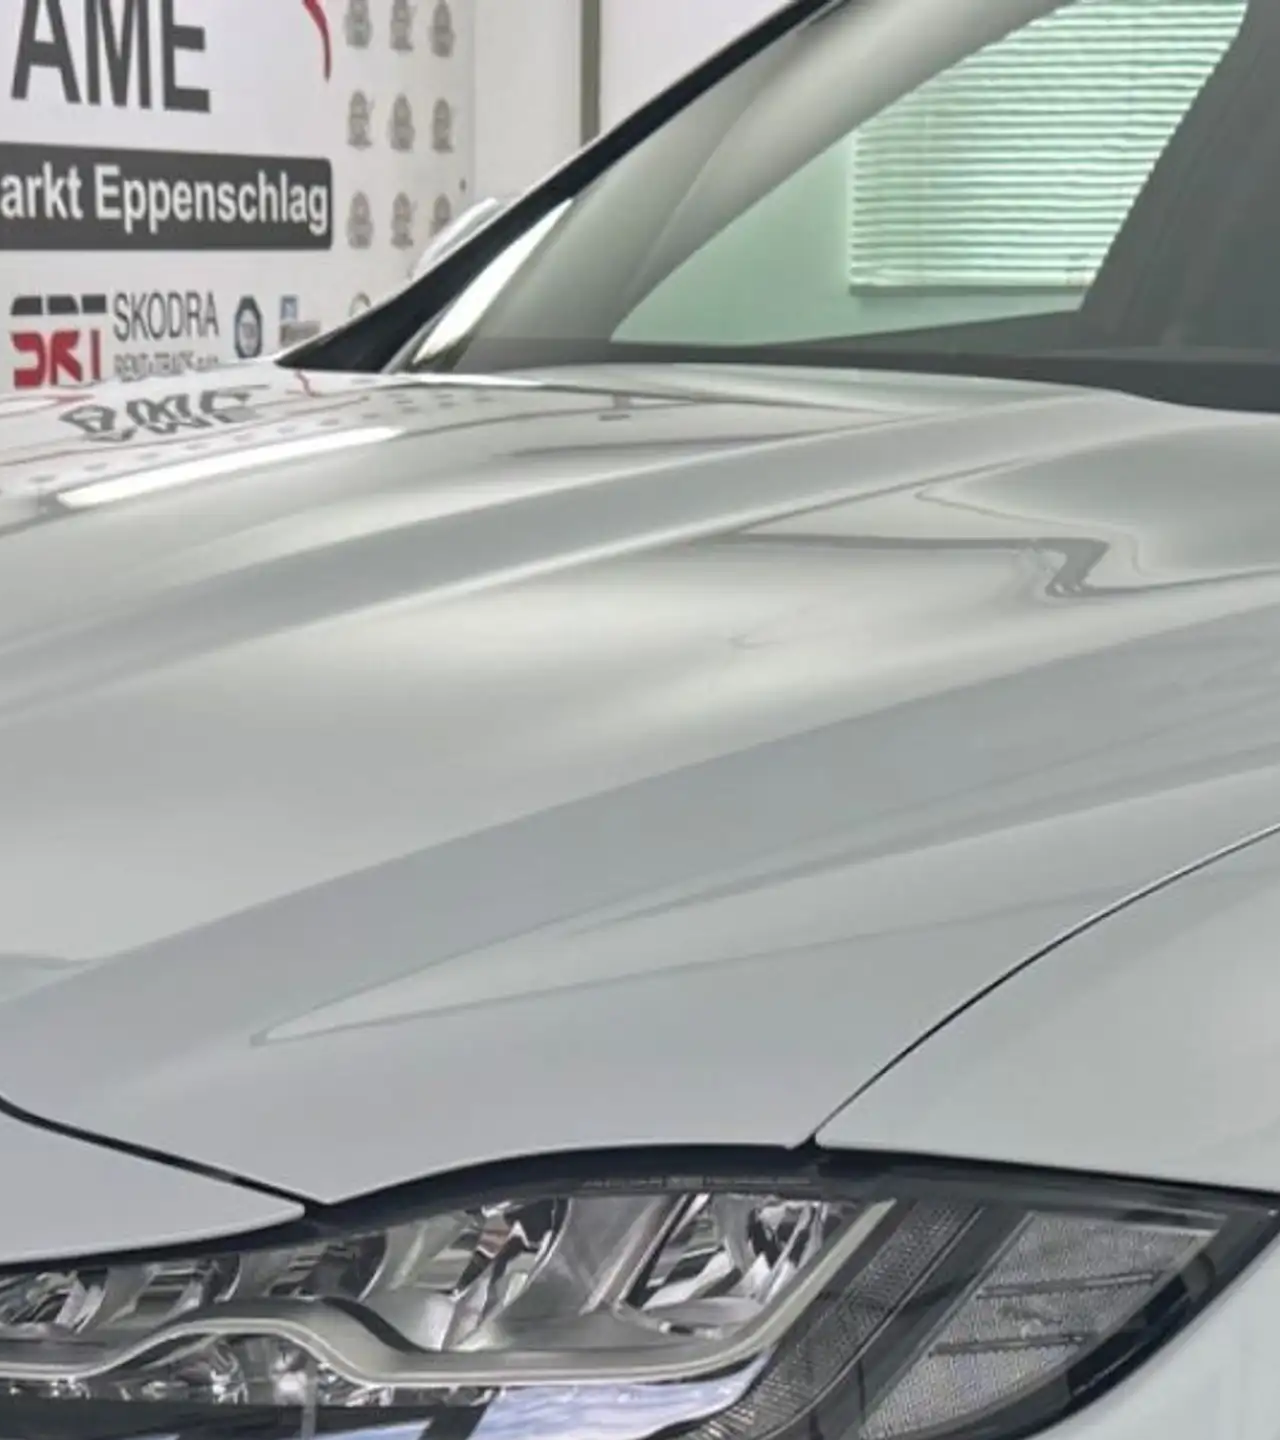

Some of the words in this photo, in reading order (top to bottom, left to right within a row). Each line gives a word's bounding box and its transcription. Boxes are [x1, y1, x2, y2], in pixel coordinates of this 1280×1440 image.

[10, 0, 211, 113] AME
[94, 163, 329, 235] Eppenschlag
[113, 289, 220, 342] SKODRA
